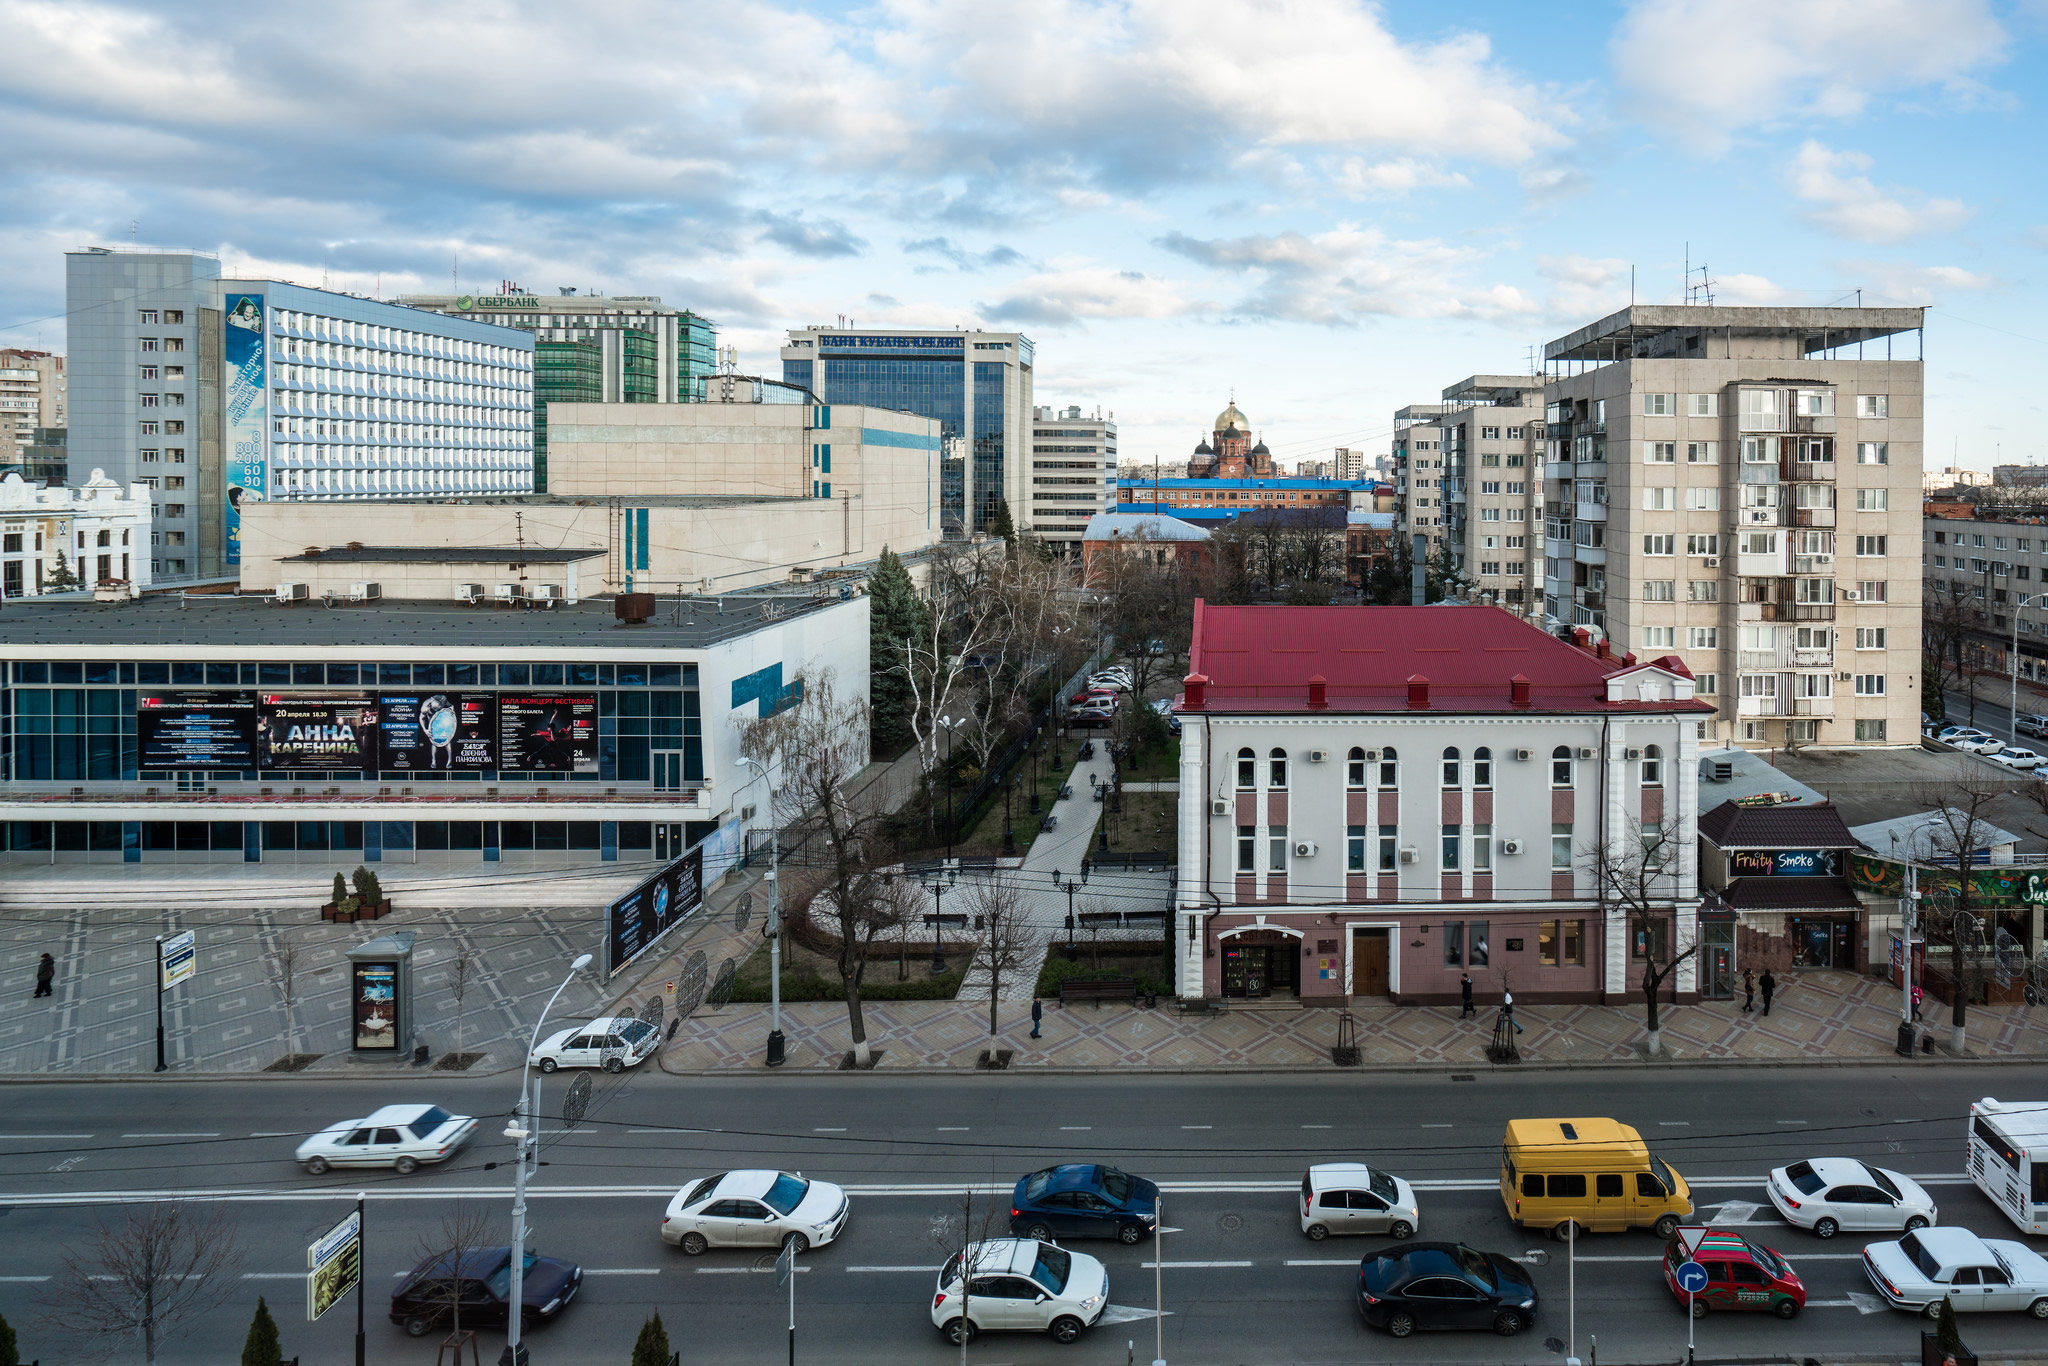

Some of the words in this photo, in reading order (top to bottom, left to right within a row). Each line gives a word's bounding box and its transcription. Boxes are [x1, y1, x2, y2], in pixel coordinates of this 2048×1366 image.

[478, 296, 539, 308] СБЕРБАНК
[822, 336, 856, 347] БАНК
[860, 336, 909, 347] КУБАНЬ
[913, 337, 964, 348] КРЕДИТ
[228, 344, 263, 396] Санаторно-
[228, 364, 262, 412] курортное
[231, 388, 259, 427] лечение
[252, 431, 261, 442] 8
[236, 442, 261, 454] 800
[236, 454, 261, 464] 200
[244, 465, 261, 476] 60
[244, 476, 261, 487] 90
[287, 725, 355, 740] АННА
[270, 742, 359, 754] КАРЕНИНА
[1736, 852, 1773, 875] Fruity
[1778, 853, 1814, 867] Smoke
